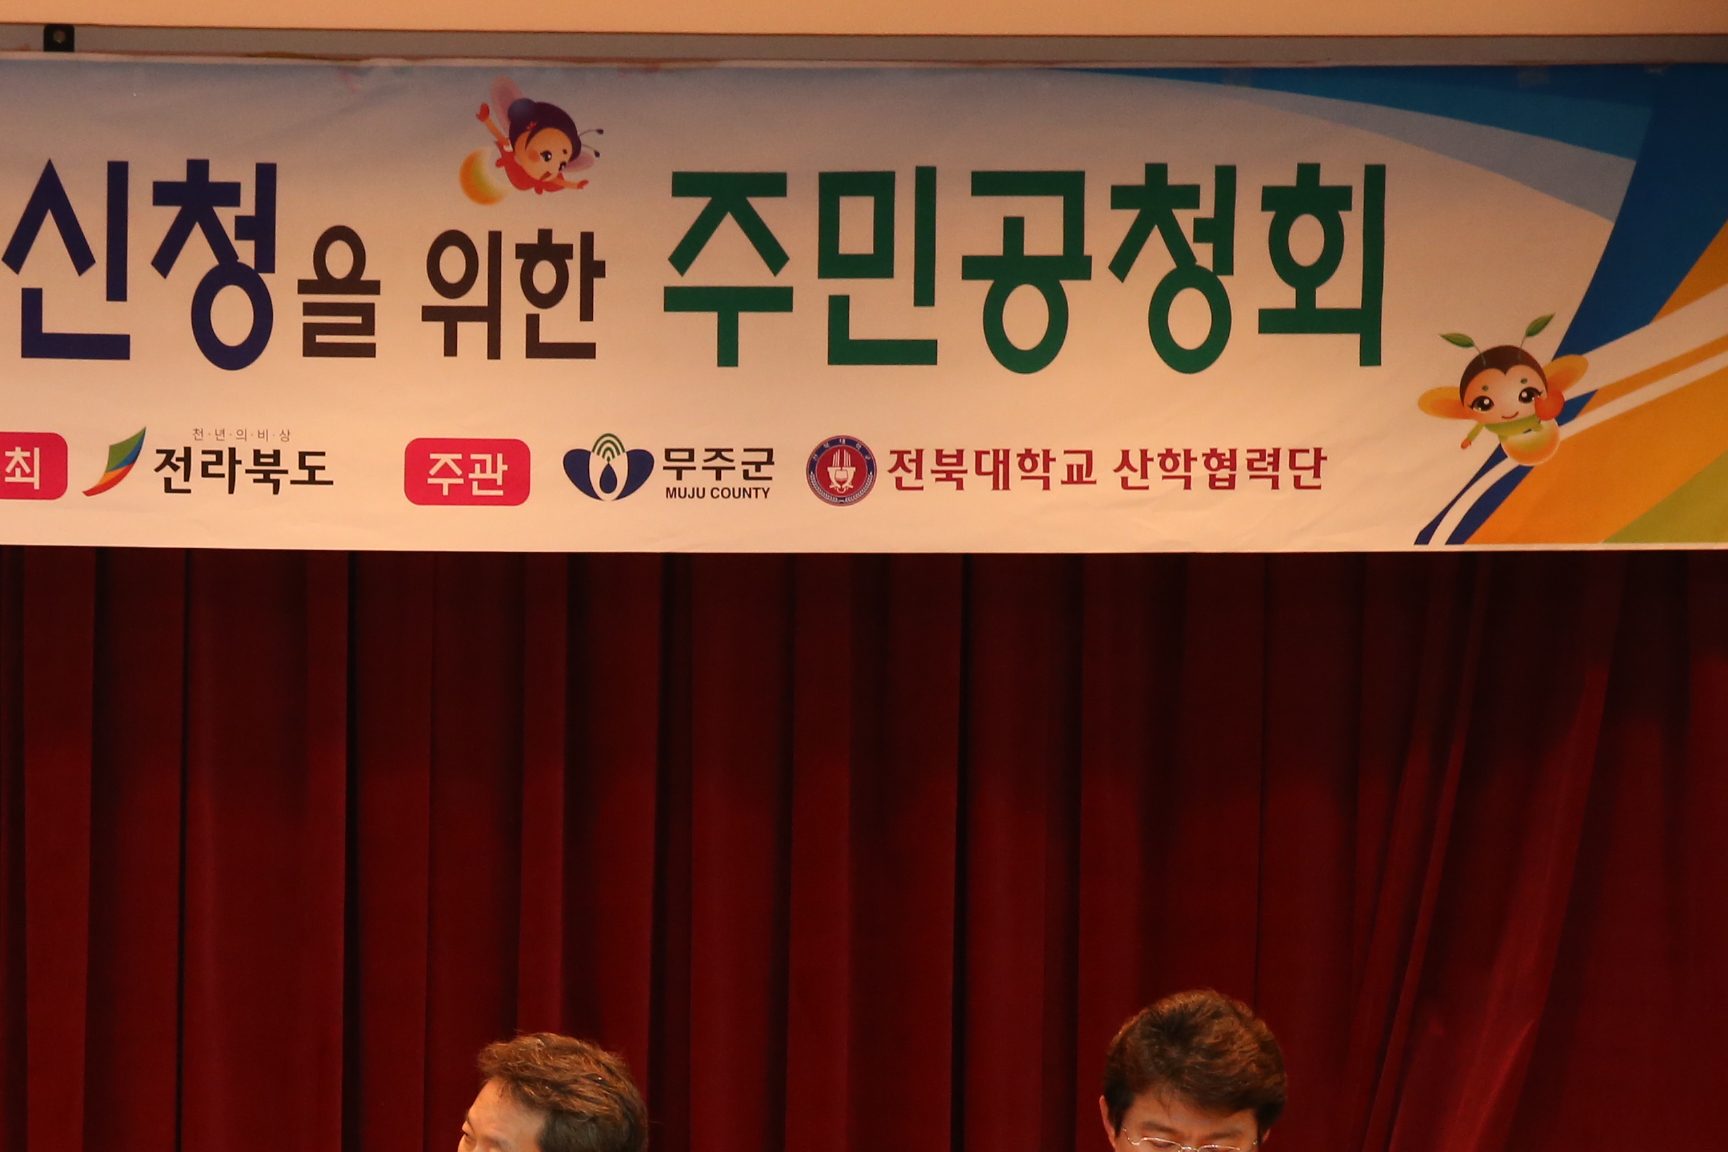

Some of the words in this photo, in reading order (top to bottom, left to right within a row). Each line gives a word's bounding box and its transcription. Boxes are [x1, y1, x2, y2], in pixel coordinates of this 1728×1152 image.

[2, 158, 380, 370] 신청을
[422, 229, 606, 360] 위한
[664, 162, 1386, 374] 주민공청회
[154, 446, 333, 495] 전라북도
[428, 453, 508, 495] 주관
[663, 448, 774, 481] 무주군
[888, 448, 1096, 491] 전북대학교
[1113, 447, 1327, 490] 산학협력단
[666, 487, 705, 499] MUJU
[711, 487, 770, 499] COUNTY
